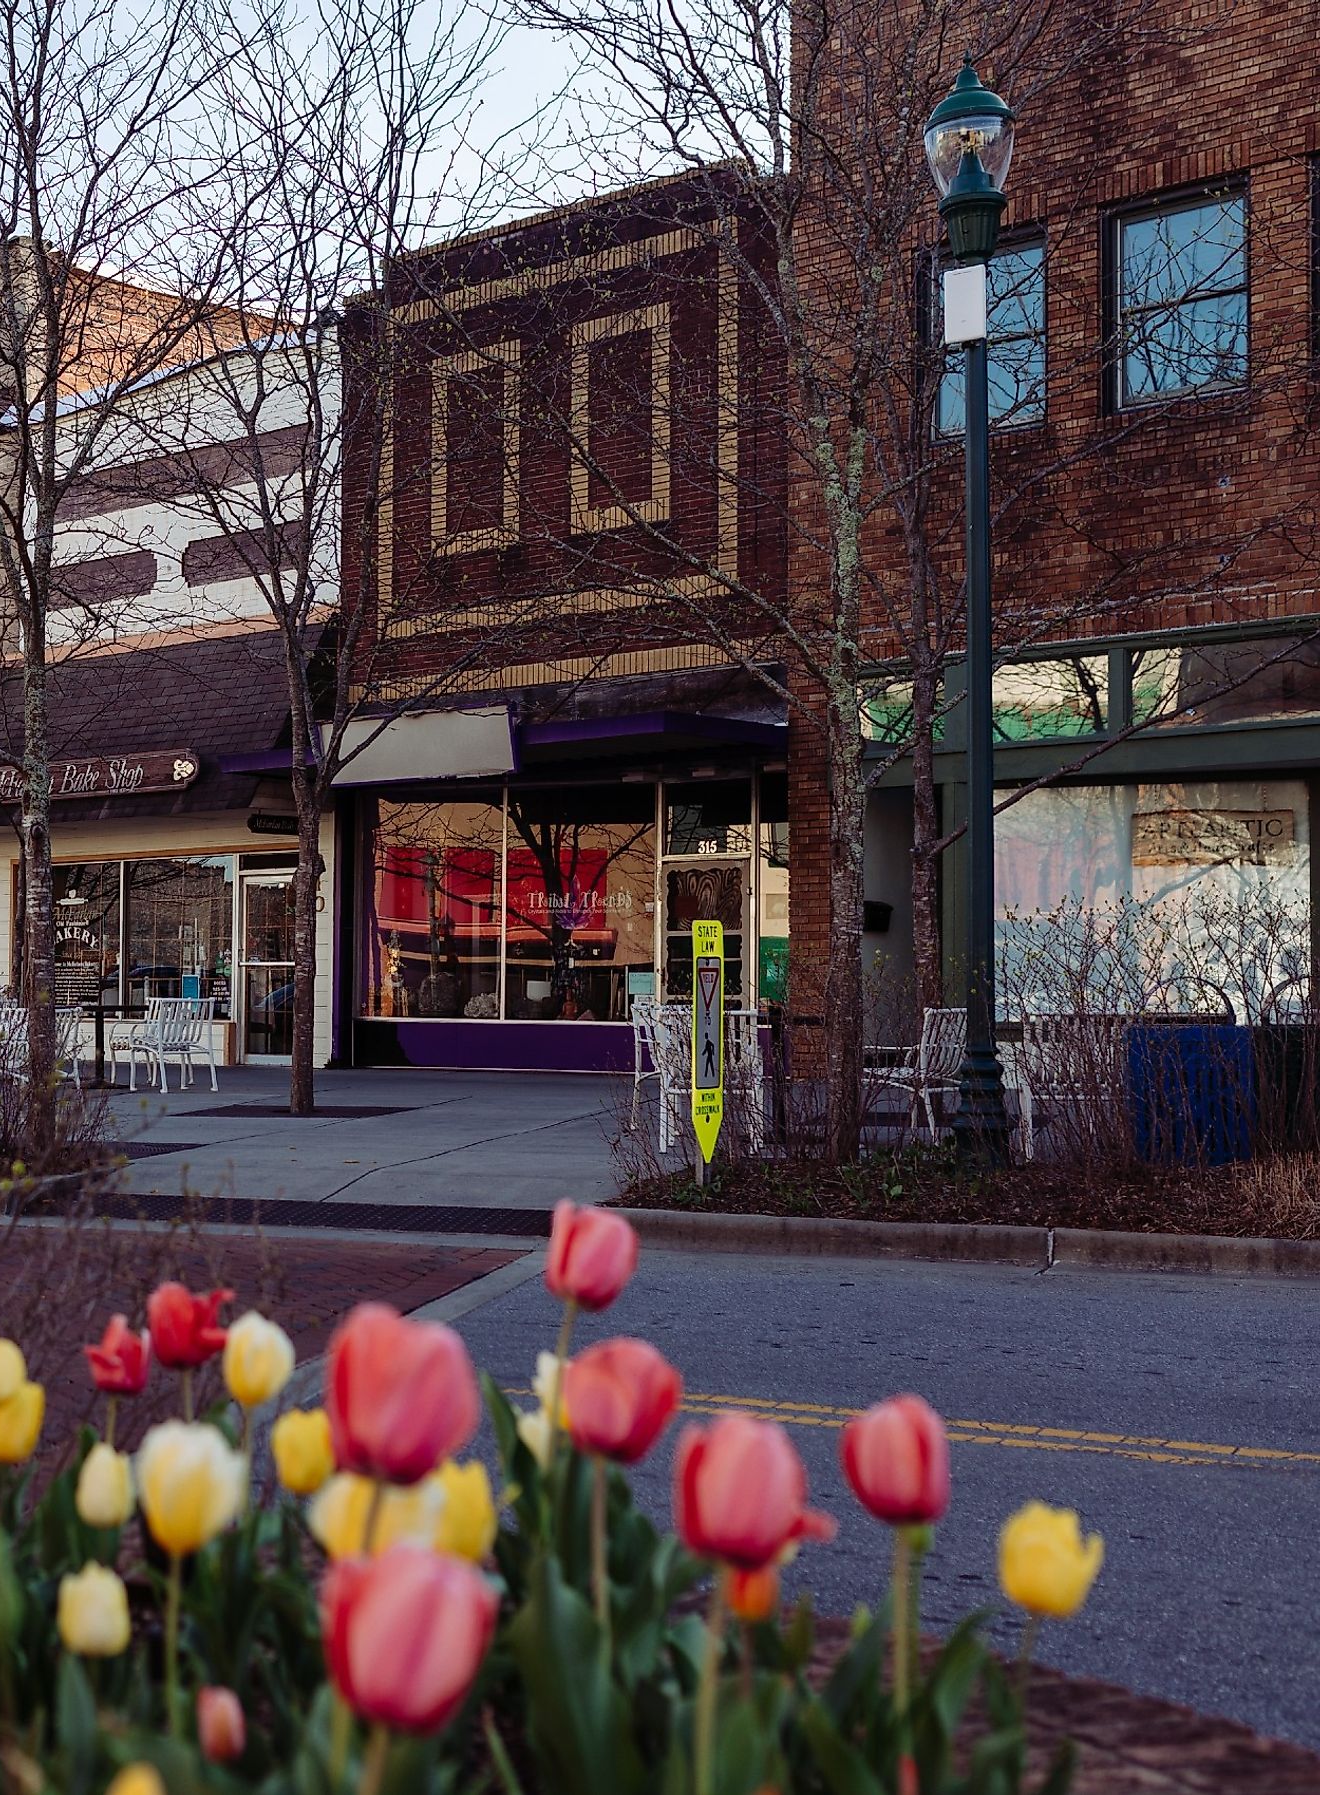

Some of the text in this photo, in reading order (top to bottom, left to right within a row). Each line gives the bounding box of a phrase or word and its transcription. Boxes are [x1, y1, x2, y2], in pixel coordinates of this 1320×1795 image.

[59, 764, 100, 794] Bake
[105, 758, 144, 791] Shop
[697, 840, 718, 854] 315
[54, 926, 100, 949] AKERY
[698, 925, 718, 938] STATE
[701, 941, 715, 953] LAW
[702, 973, 714, 984] YIELD
